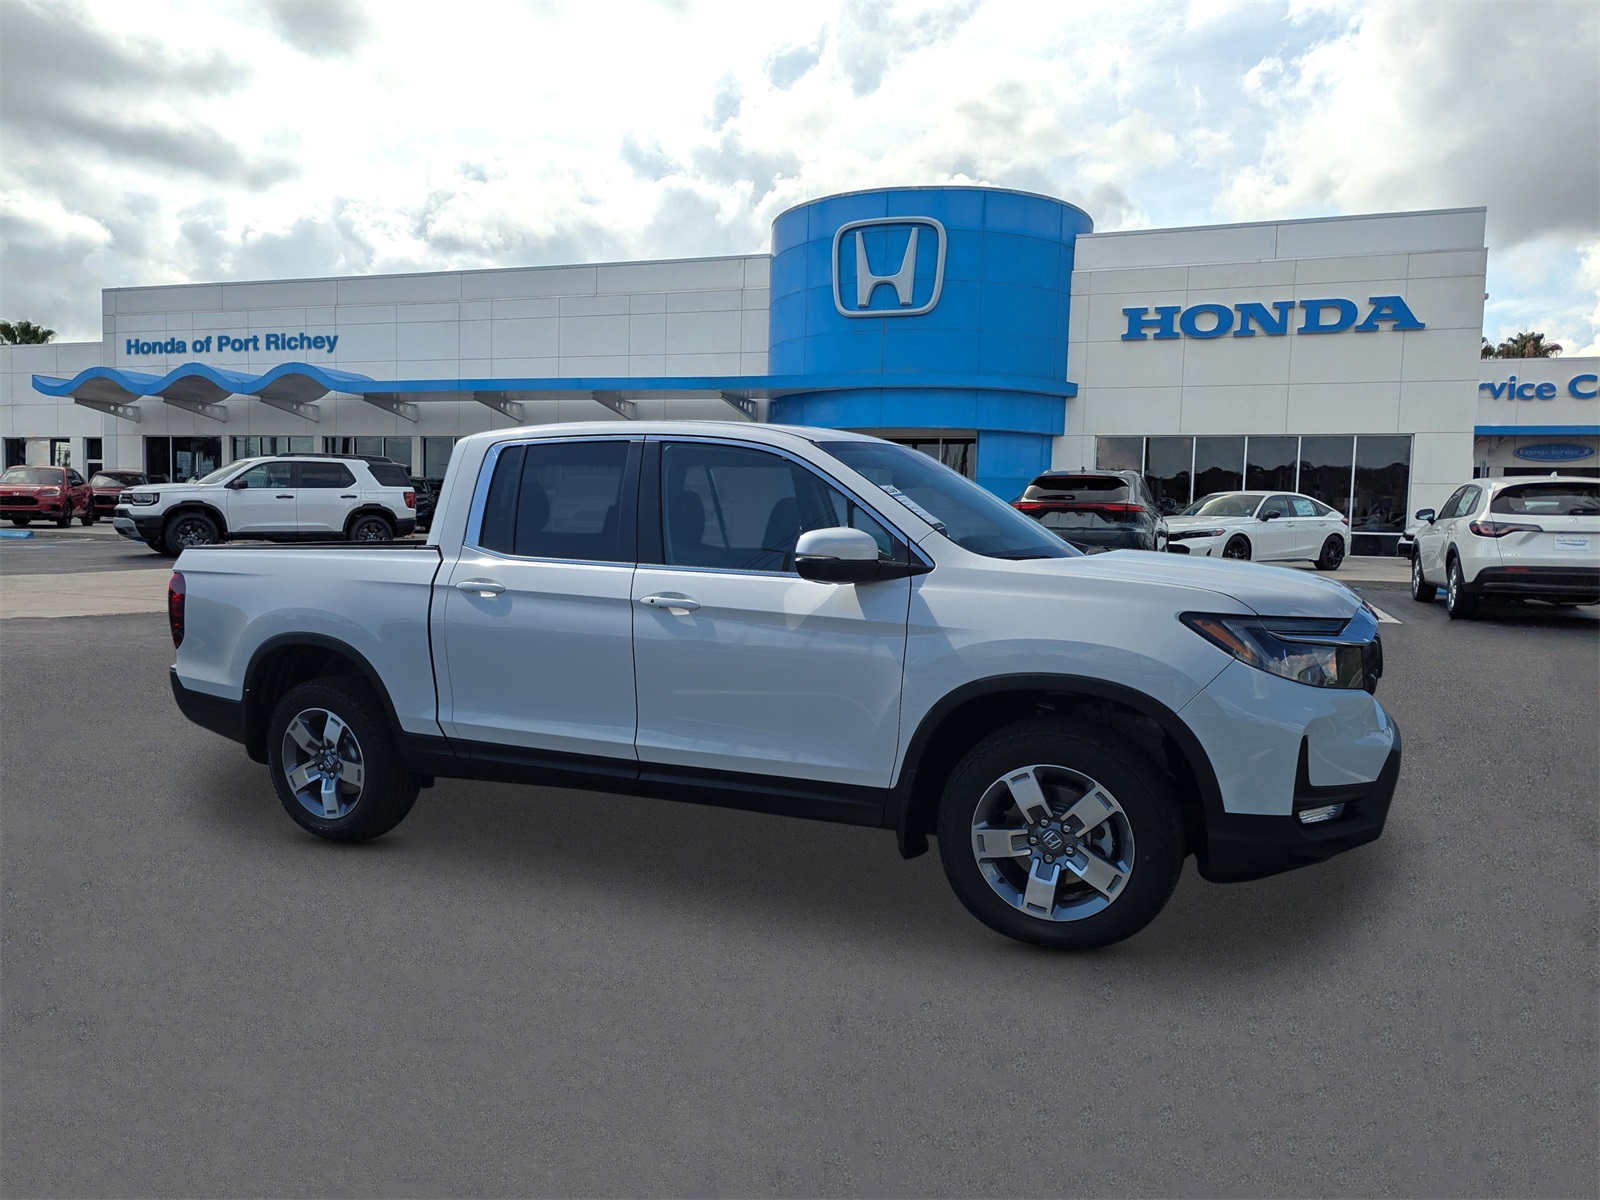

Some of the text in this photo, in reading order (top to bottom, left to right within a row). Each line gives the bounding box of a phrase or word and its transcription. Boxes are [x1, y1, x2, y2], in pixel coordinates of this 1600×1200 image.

[1121, 295, 1426, 341] HONDA
[126, 332, 339, 355] Honda of Port Richey
[1519, 448, 1579, 457] Express Service
